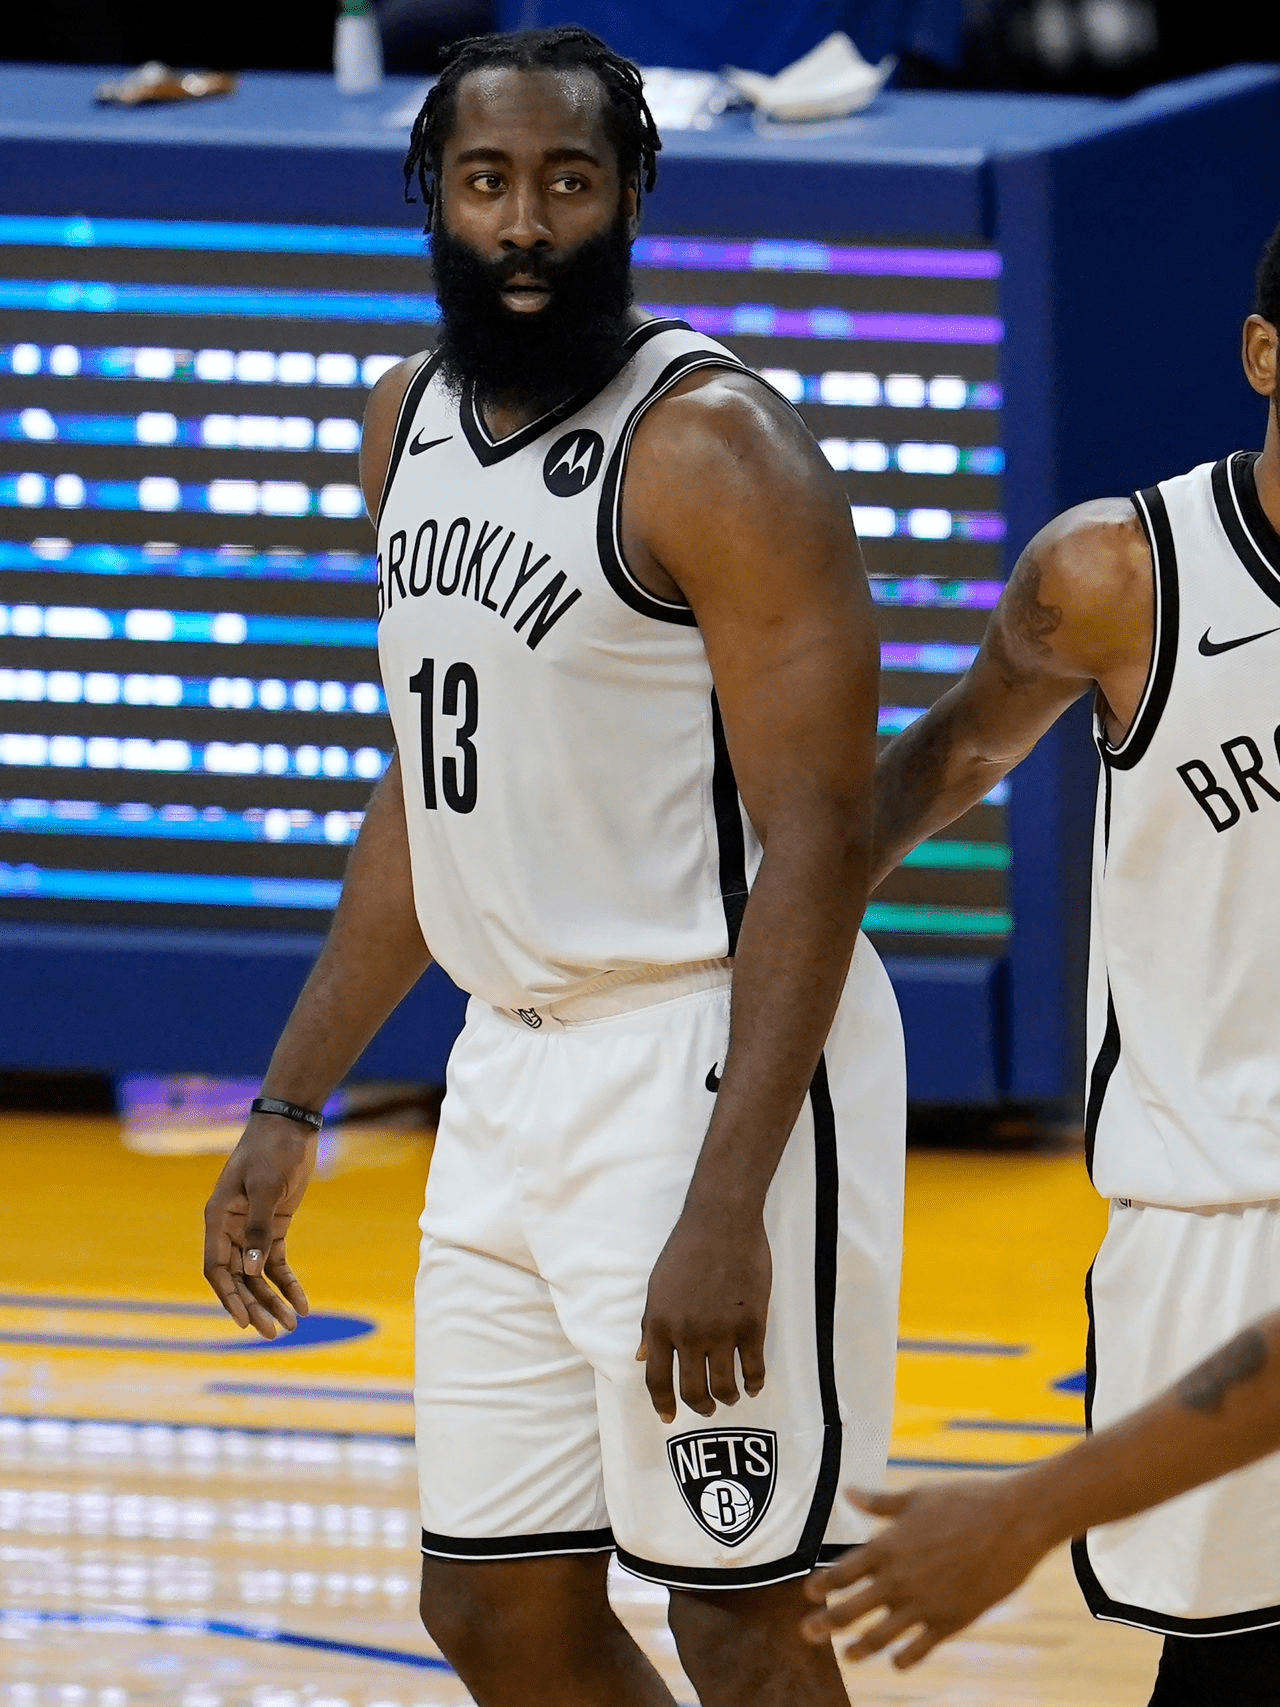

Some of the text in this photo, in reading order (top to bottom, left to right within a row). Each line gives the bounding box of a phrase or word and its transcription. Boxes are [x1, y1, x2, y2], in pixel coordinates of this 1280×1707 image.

[409, 658, 479, 814] 13
[676, 1436, 771, 1484] NETS
[716, 1487, 737, 1527] B
